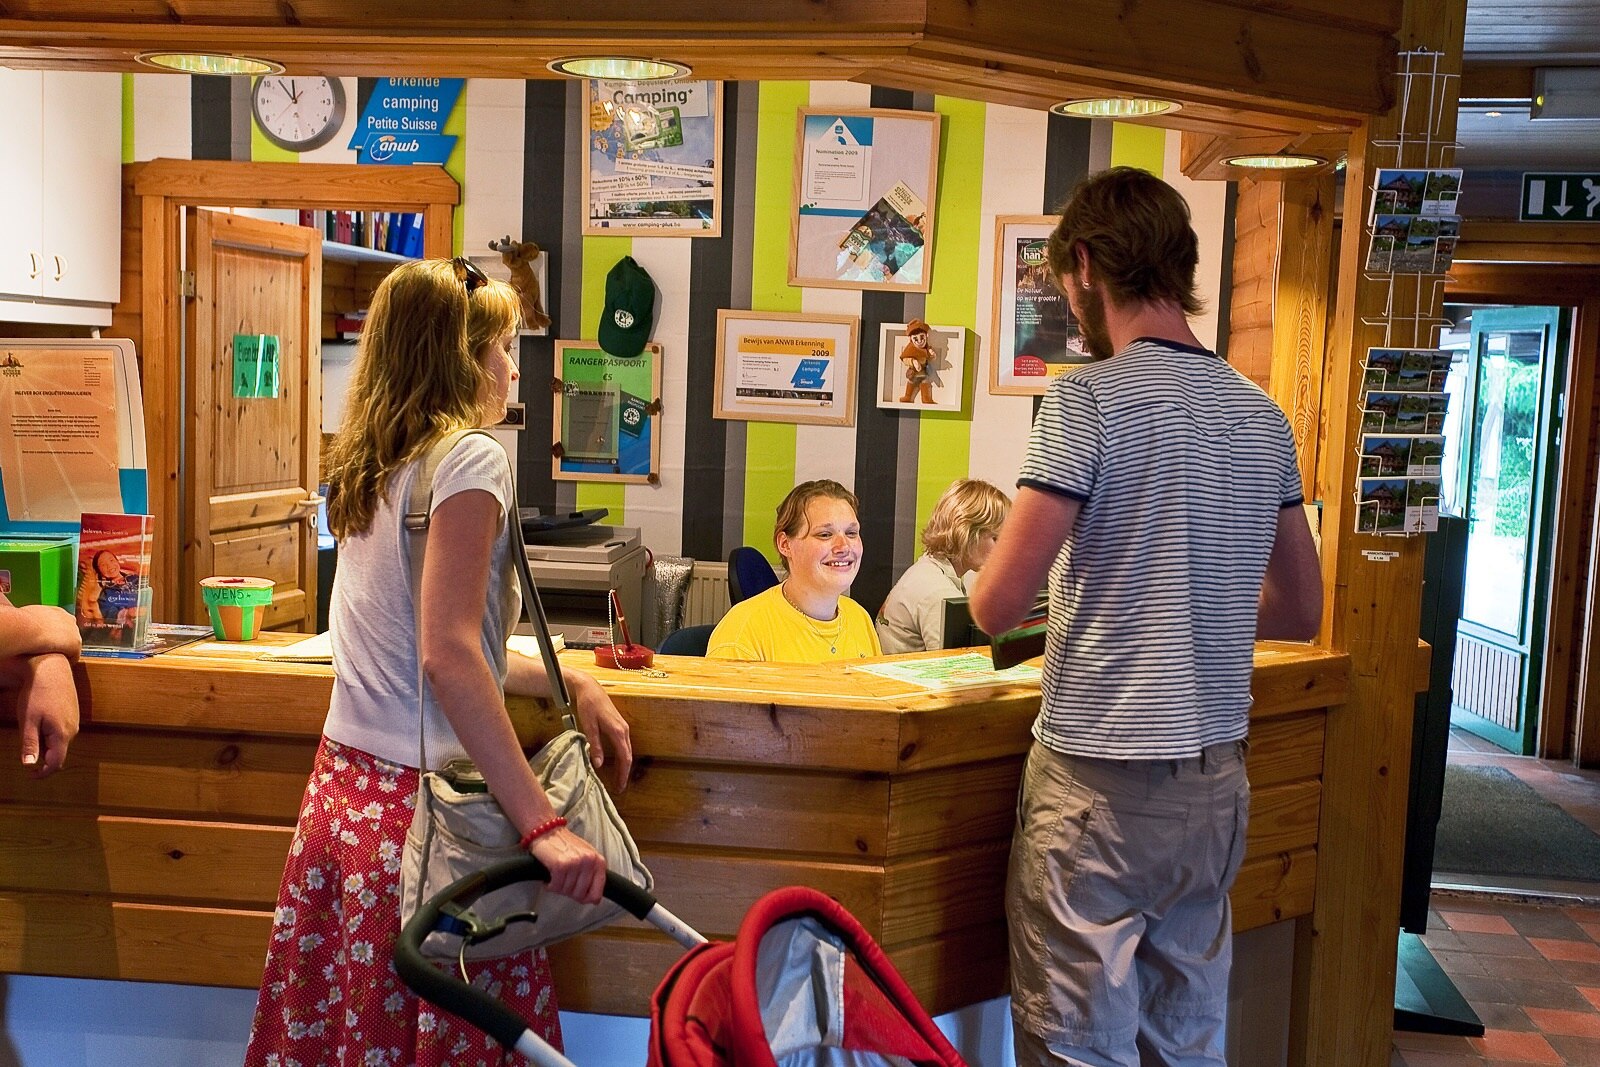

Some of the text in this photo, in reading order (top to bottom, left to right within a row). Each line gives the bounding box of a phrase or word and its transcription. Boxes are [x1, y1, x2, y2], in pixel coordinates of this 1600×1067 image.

[321, 79, 327, 87] 2
[382, 96, 439, 112] camping
[367, 117, 437, 130] Petite Suisse
[379, 138, 420, 152] anwb
[1024, 247, 1041, 260] han
[743, 338, 763, 346] Bewijs
[795, 340, 825, 348] Erkenning
[569, 357, 647, 368] RANGERPASPOORT
[602, 373, 613, 381] €5
